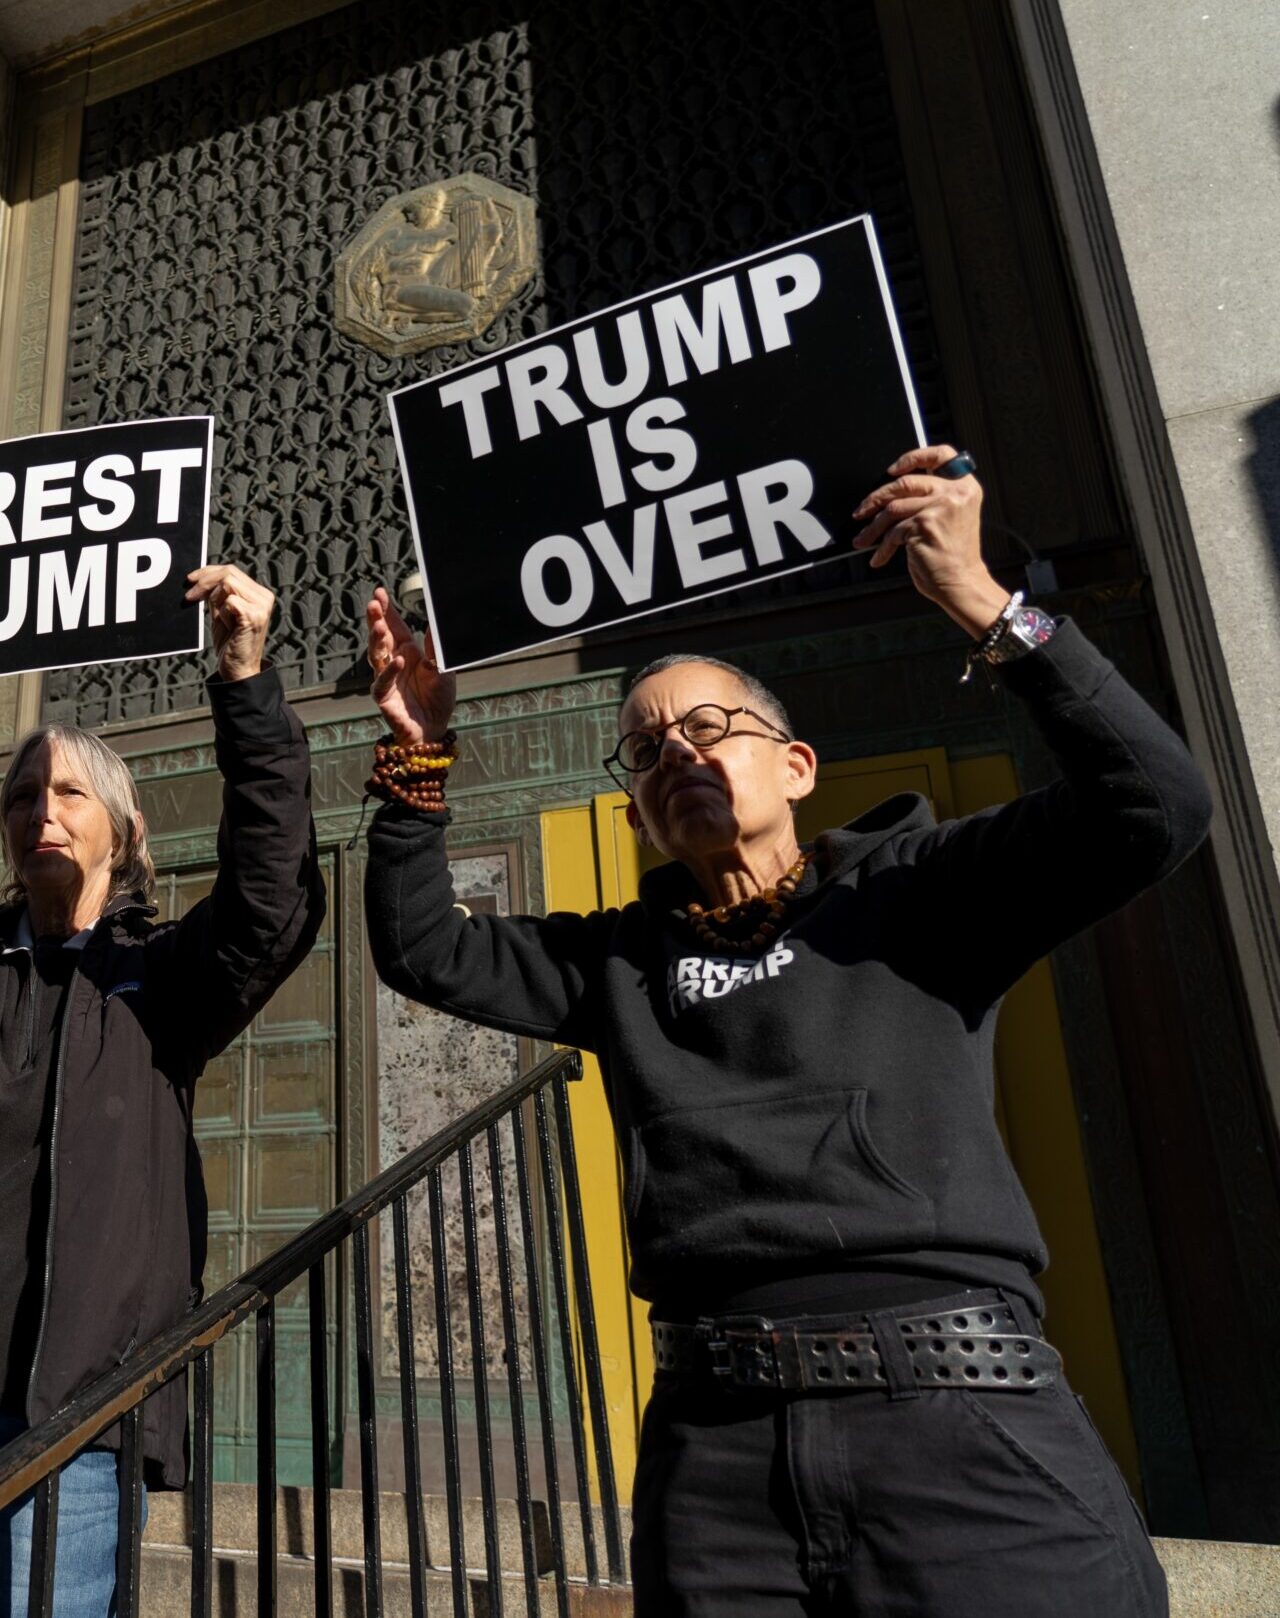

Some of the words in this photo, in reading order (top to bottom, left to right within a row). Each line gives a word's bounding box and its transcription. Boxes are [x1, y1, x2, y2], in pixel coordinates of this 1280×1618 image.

[439, 253, 821, 459] TRUMP
[587, 397, 697, 509] IS
[520, 459, 833, 628] OVER
